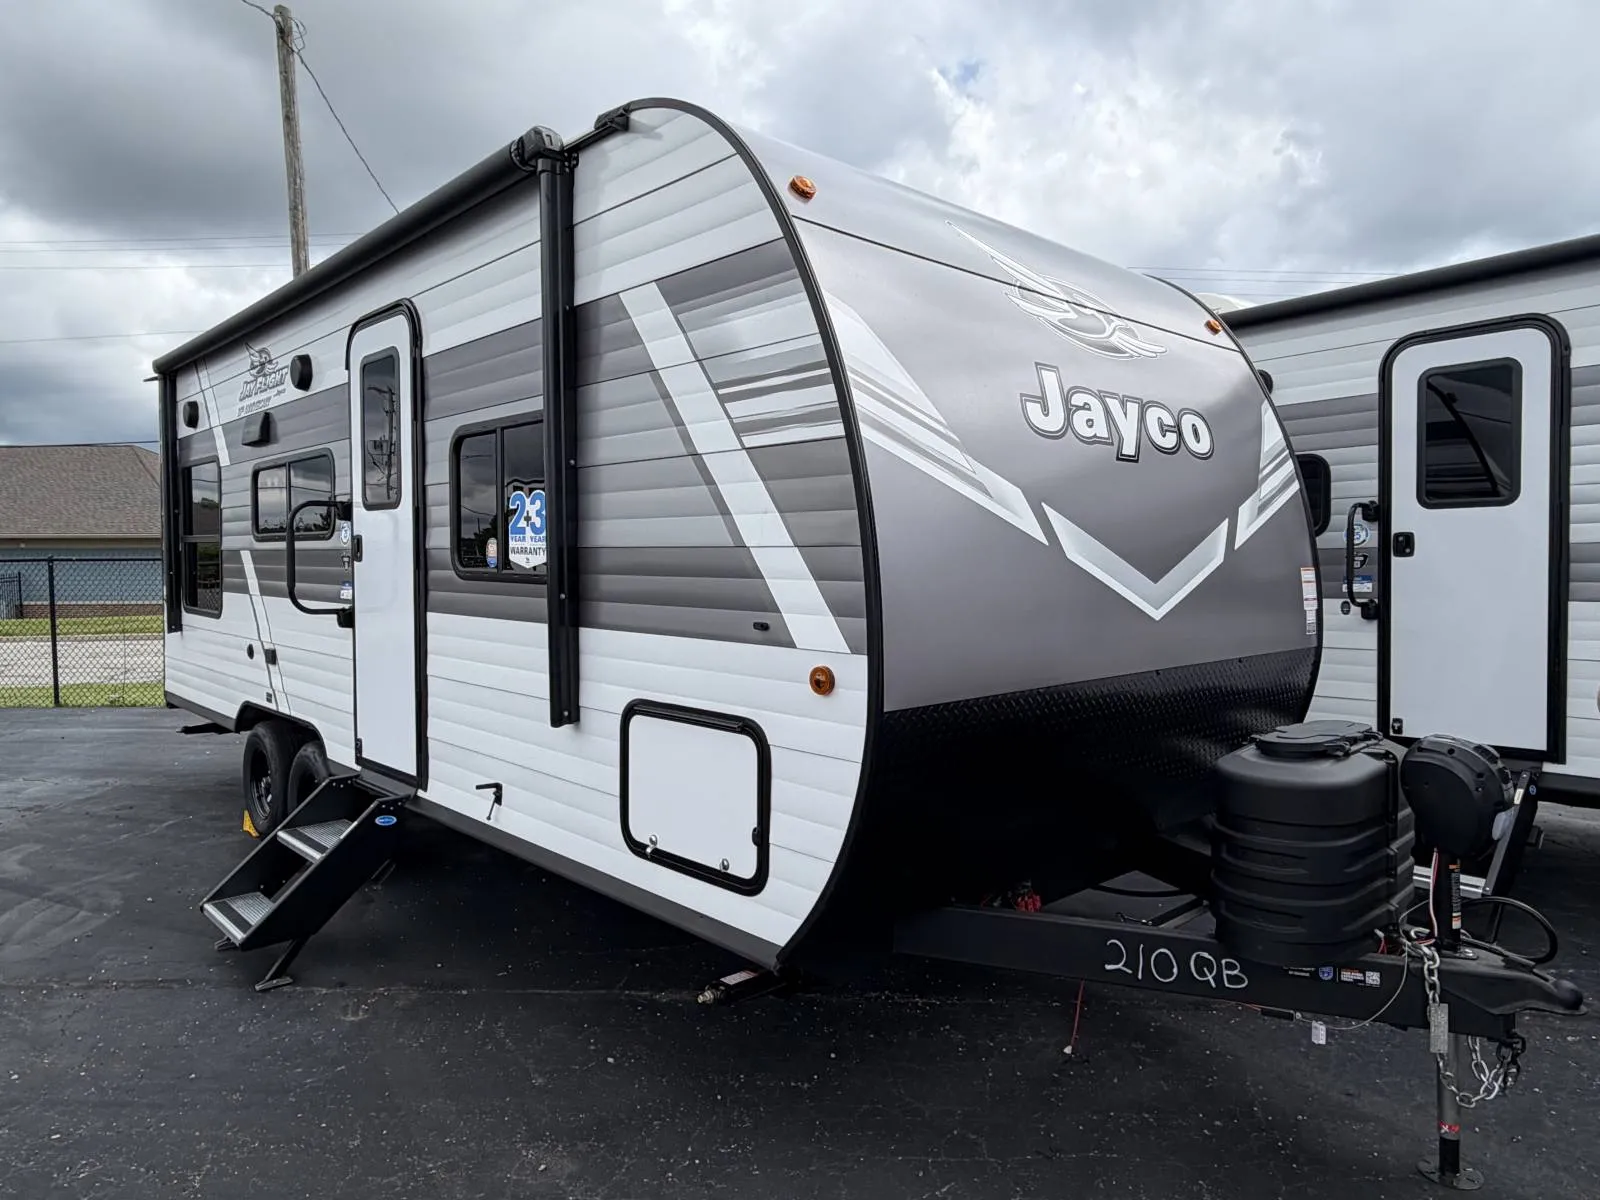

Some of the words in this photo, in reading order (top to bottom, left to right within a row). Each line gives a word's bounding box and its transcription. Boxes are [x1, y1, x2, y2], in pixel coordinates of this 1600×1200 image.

[255, 365, 289, 394] FLIGHT
[1019, 361, 1214, 463] Jayco
[510, 546, 546, 556] WARRANTY
[1104, 938, 1178, 983] 210
[1190, 951, 1249, 989] QB
